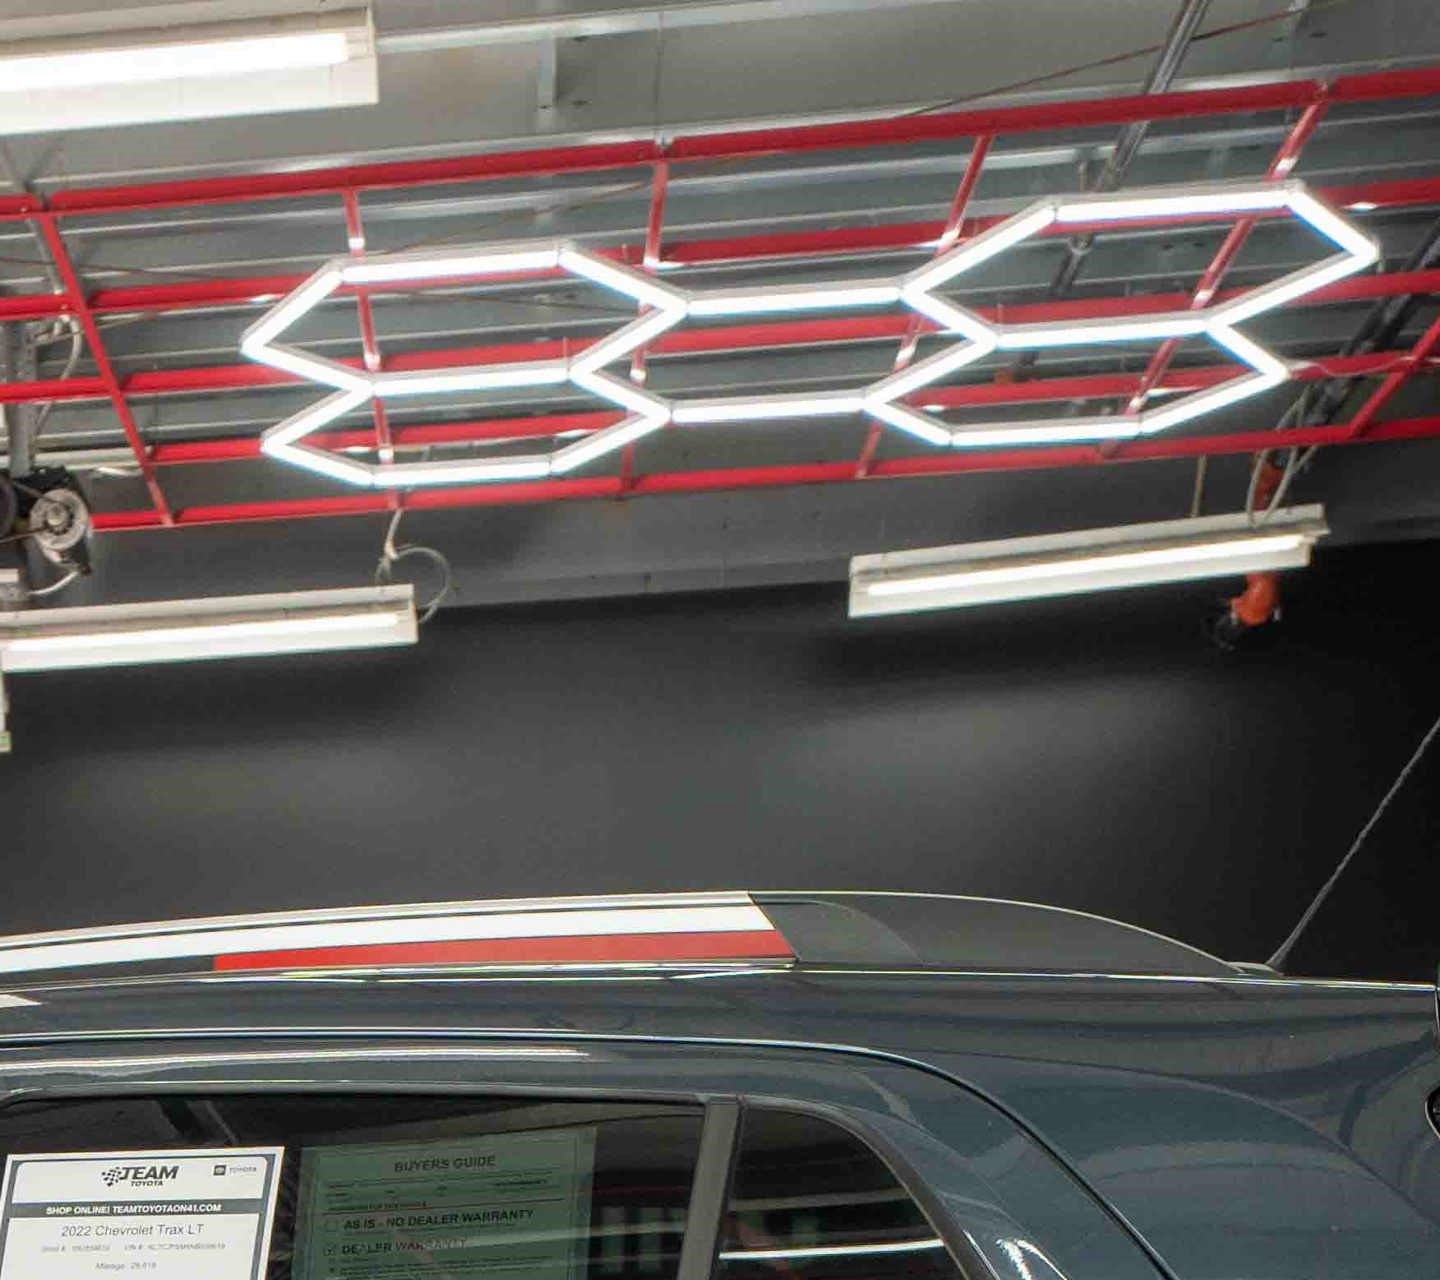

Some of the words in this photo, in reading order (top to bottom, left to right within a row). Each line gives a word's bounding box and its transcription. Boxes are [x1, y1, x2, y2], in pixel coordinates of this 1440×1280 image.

[452, 1155, 496, 1169] GUIDE
[121, 1166, 179, 1180] TEAM
[46, 1206, 72, 1215] SHOP
[74, 1205, 110, 1215] ONLINE!
[344, 1220, 361, 1230] AS
[363, 1220, 375, 1229] IS
[386, 1217, 405, 1227] NO
[407, 1214, 461, 1227] DEALER
[462, 1209, 534, 1223] WARRANTY
[61, 1225, 92, 1237] 2022
[95, 1224, 153, 1236] Chevrolet
[157, 1224, 184, 1235] Trax
[188, 1223, 205, 1234] LT
